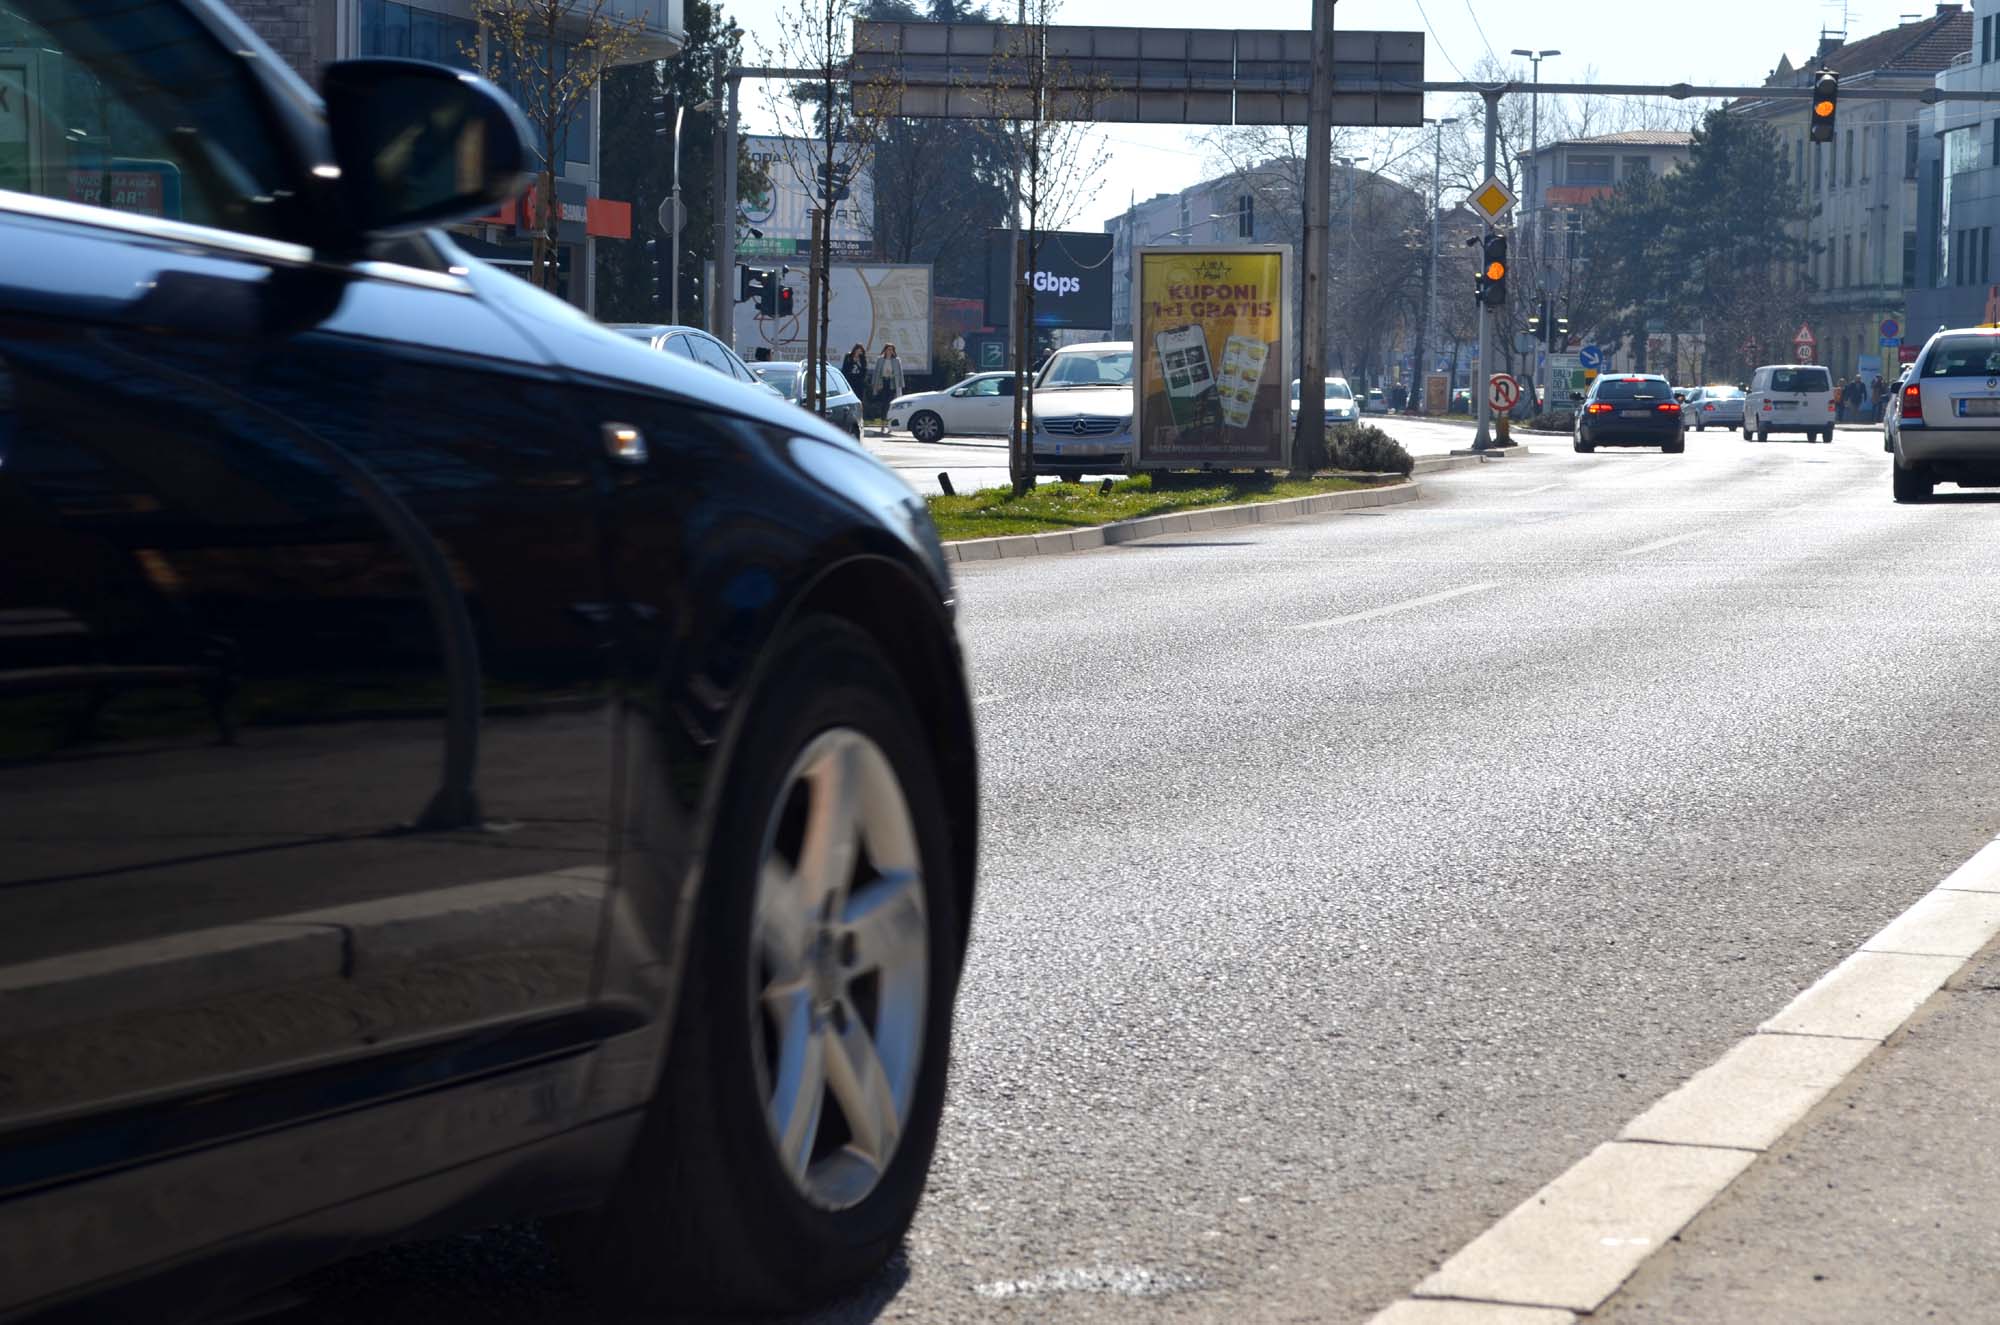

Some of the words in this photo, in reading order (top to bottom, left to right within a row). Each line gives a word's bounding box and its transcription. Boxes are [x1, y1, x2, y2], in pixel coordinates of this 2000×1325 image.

[76, 188, 146, 204] "POAR"
[806, 208, 862, 221] SAT
[1168, 284, 1256, 301] KUPONI
[1190, 301, 1273, 317] GRATIS
